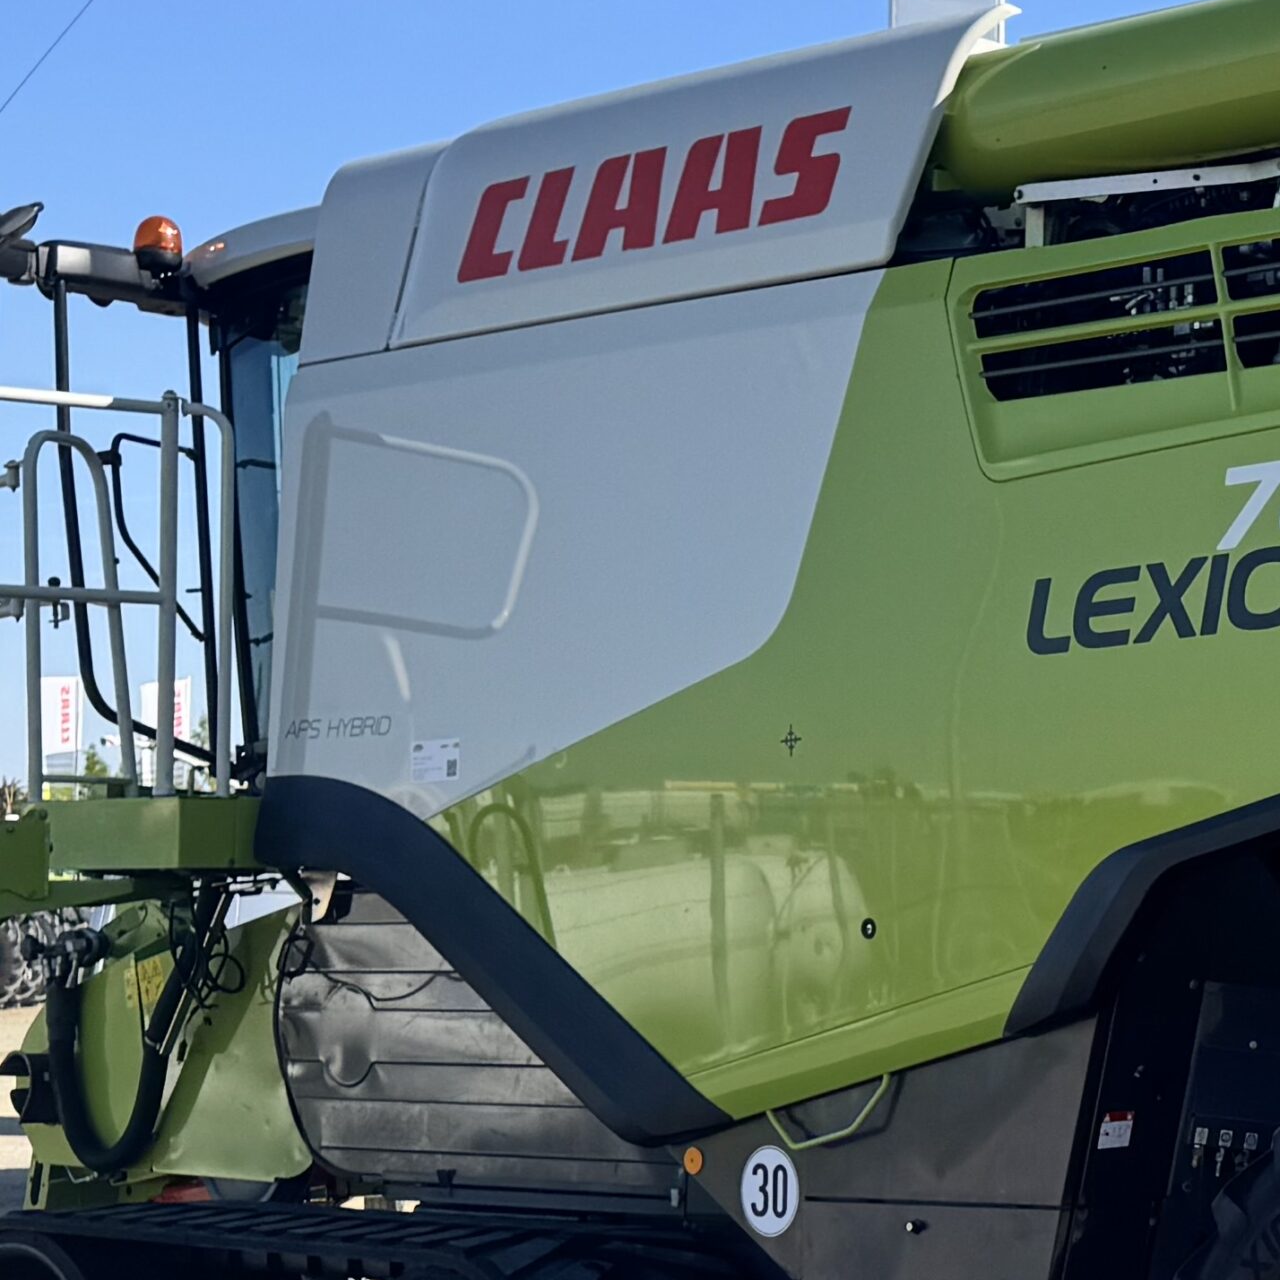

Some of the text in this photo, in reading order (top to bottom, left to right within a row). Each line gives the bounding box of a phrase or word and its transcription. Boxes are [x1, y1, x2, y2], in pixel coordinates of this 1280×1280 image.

[457, 105, 853, 283] CLAAS
[285, 715, 392, 740] APS HYBRID
[751, 1163, 788, 1218] 30
